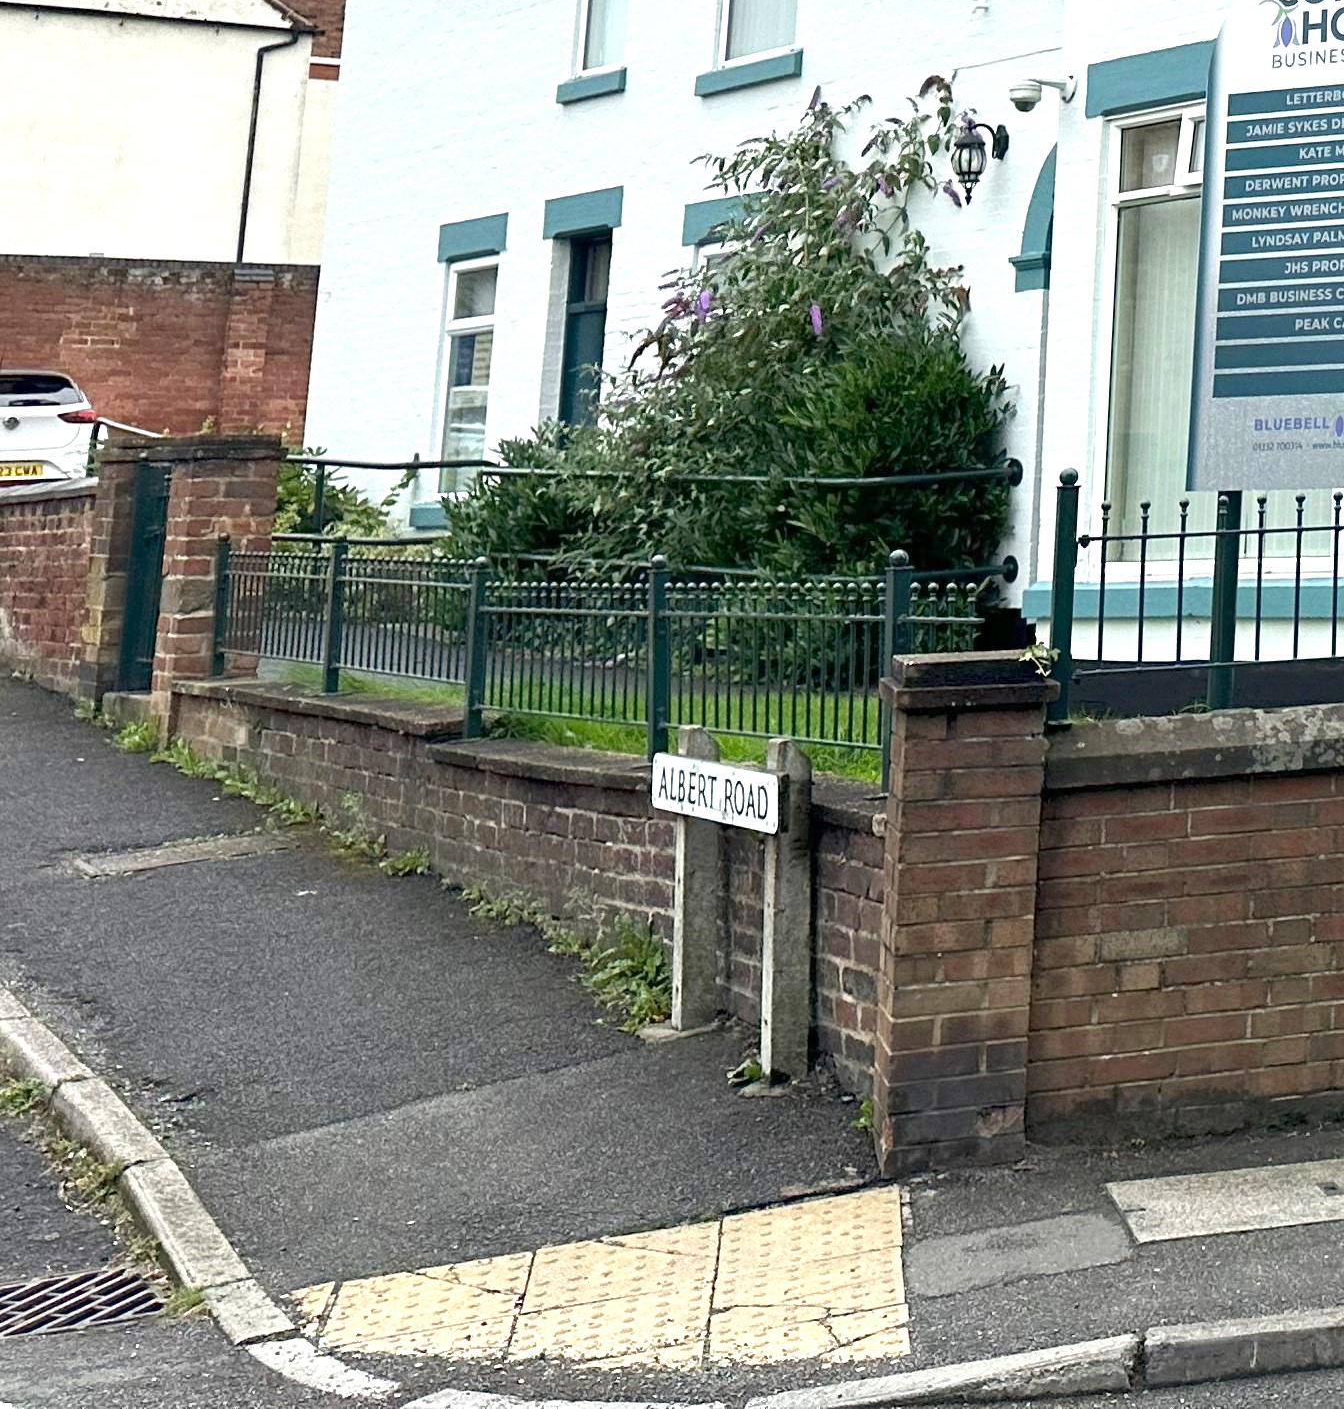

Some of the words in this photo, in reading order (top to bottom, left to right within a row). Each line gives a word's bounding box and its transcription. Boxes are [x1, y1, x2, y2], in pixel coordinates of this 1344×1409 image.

[1245, 122, 1285, 137] JAMIE
[1287, 118, 1328, 133] SYKES
[1299, 146, 1331, 160] KATE
[1245, 176, 1309, 192] DERWENT
[1231, 205, 1286, 221] MONKEY
[1251, 233, 1309, 248] LYNDSAY
[1284, 262, 1309, 274] JHS
[1236, 292, 1266, 305] DMB
[1269, 287, 1333, 303] BUSINESS
[1295, 318, 1330, 331] PEAK
[1254, 416, 1330, 431] BLUEBELL
[658, 766, 717, 810] ALBERT
[723, 778, 769, 820] ROAD
